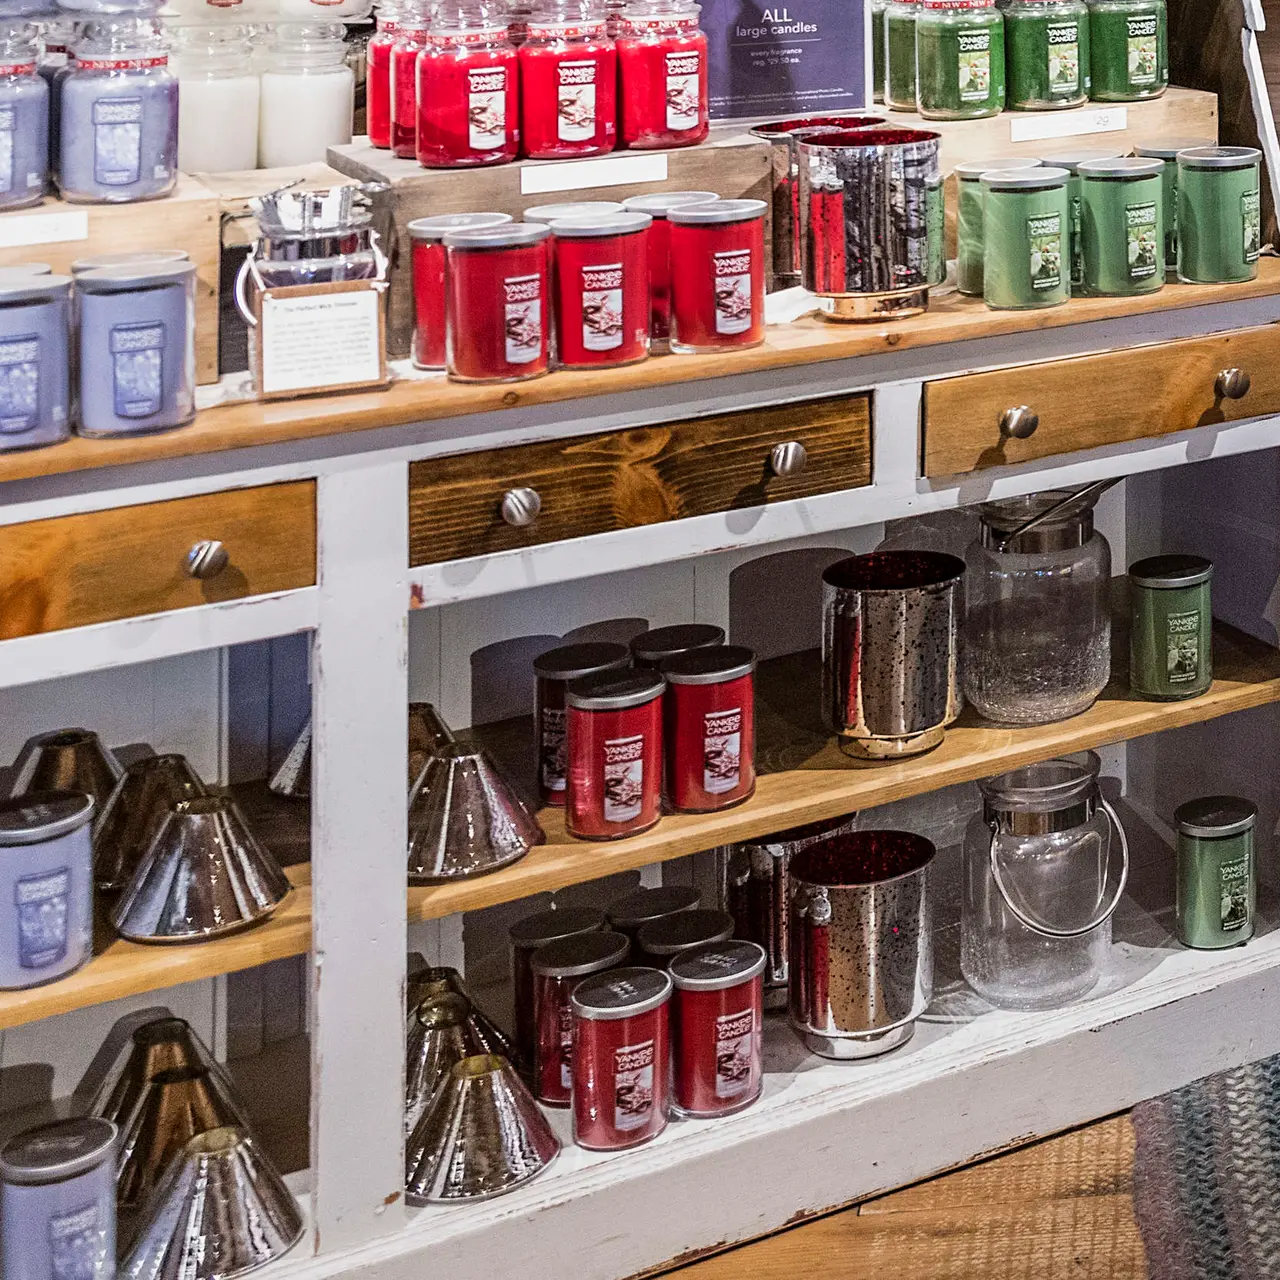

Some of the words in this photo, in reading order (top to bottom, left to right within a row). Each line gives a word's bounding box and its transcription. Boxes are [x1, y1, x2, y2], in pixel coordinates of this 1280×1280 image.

[761, 8, 793, 23] ALL
[736, 26, 767, 39] large
[770, 21, 818, 35] candles
[1128, 28, 1156, 36] CANDLE
[1049, 35, 1077, 43] CANDLE
[751, 49, 770, 58] every
[770, 47, 803, 57] fragrance
[716, 264, 750, 275] CANDLE
[584, 279, 622, 290] CANDLE
[1169, 622, 1198, 633] CANDLE
[706, 723, 741, 736] CANDLE
[606, 751, 643, 763] CANDLE
[718, 1025, 752, 1040] CANDLE
[617, 1056, 653, 1071] CANDLE
